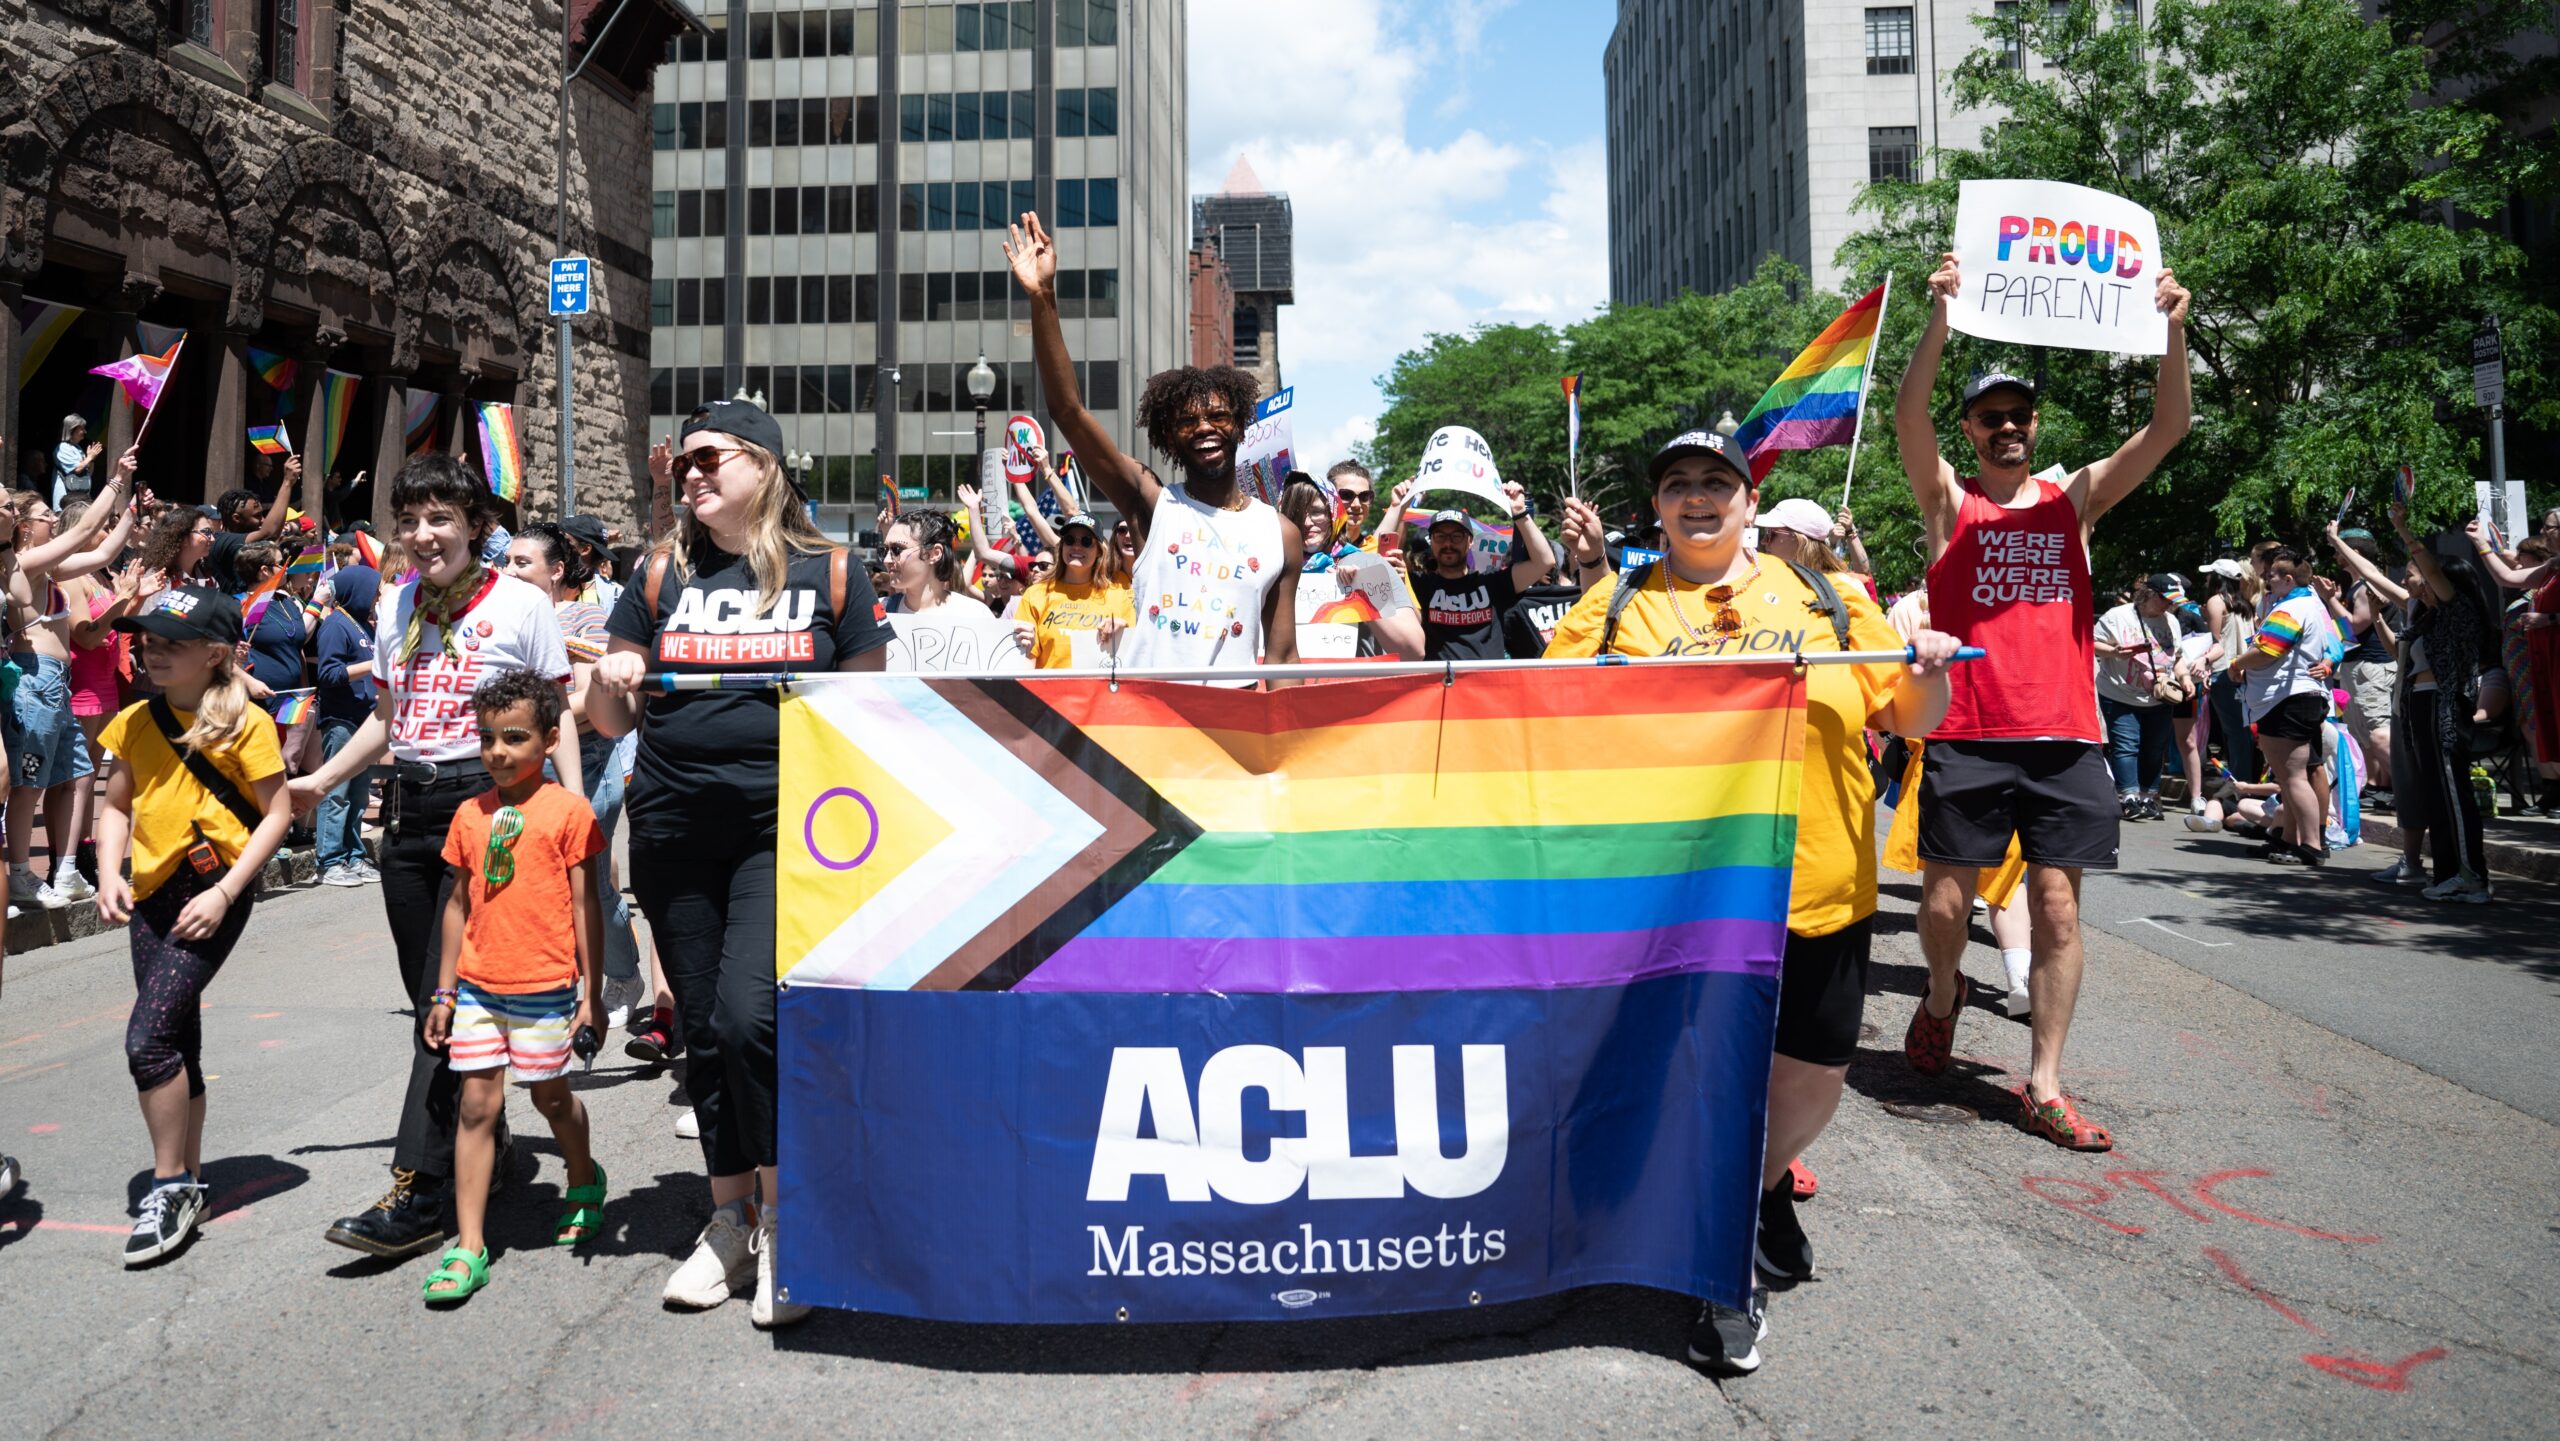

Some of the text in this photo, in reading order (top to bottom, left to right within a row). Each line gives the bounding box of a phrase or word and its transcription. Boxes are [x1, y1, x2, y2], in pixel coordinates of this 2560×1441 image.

[1997, 215, 2143, 279] PROUD
[554, 273, 584, 282] METER
[561, 263, 577, 271] PAY
[557, 283, 581, 292] HERE
[1981, 273, 2132, 327] PARENT
[2473, 334, 2498, 350] PARK
[2474, 346, 2499, 359] BOSTON
[1267, 391, 1291, 414] ACLU
[1247, 418, 1282, 448] BOOK
[1465, 435, 1495, 464] Her
[1176, 555, 1245, 580] PRIDE
[1627, 551, 1646, 566] WE
[1983, 547, 2062, 566] HERE
[1976, 566, 2070, 585] WE'RE
[1162, 592, 1237, 619] BLACK
[1429, 586, 1490, 612] ACLU
[1972, 584, 2074, 607] QUEER
[664, 587, 816, 634] ACLU
[1430, 609, 1492, 624] WE THE PEOPLE
[664, 635, 810, 660] WE THE PEOPLE
[395, 674, 476, 694] HERE
[391, 719, 480, 742] QUEER
[1086, 1044, 1509, 1205] ACLU
[1087, 1221, 1506, 1277] Massachusetts
